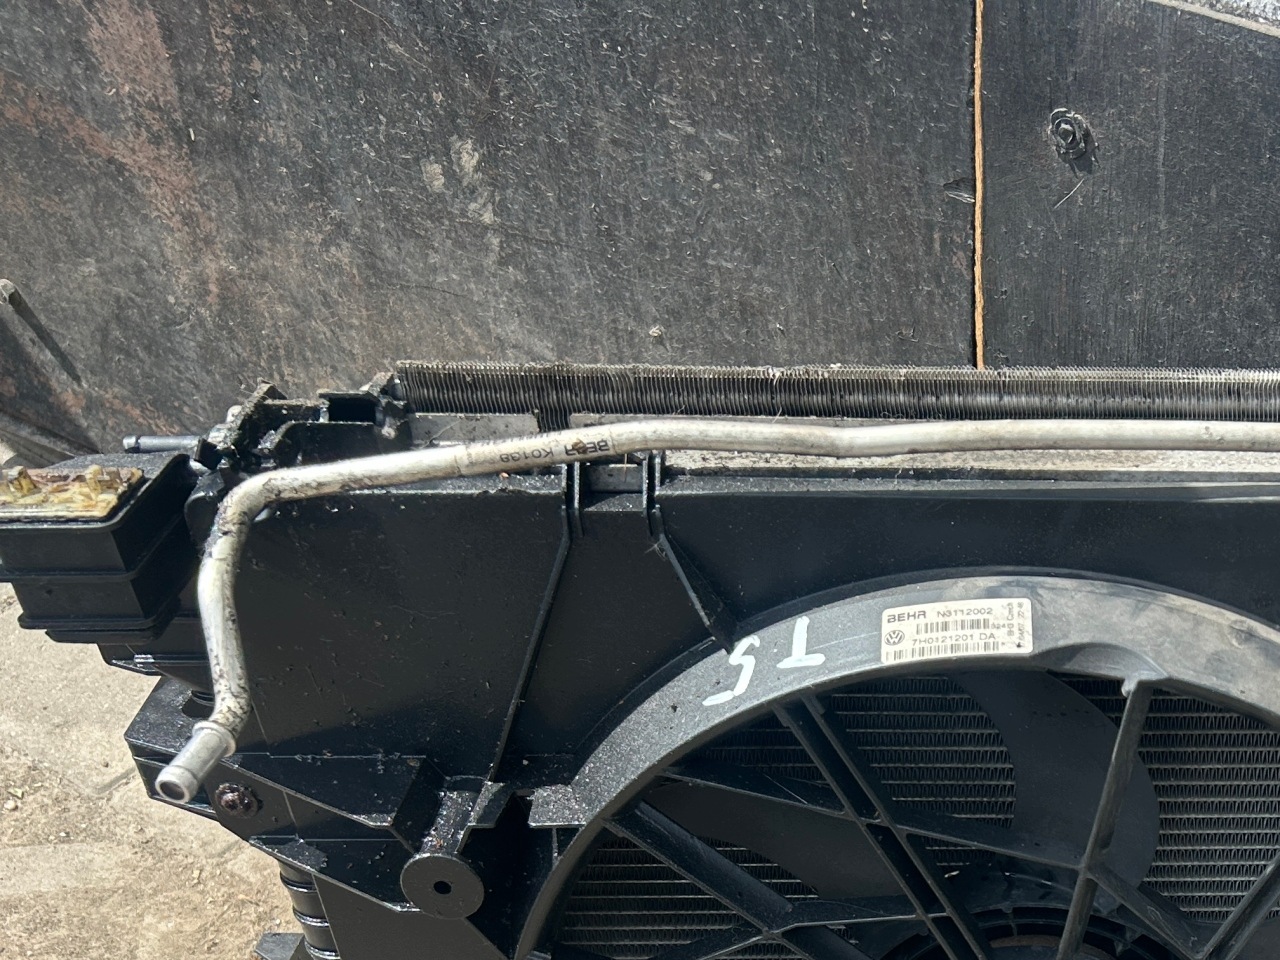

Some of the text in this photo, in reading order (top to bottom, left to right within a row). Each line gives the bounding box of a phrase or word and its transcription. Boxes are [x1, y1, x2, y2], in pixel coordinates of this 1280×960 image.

[564, 439, 610, 457] BER
[887, 610, 927, 623] BEHR
[979, 632, 996, 641] DA
